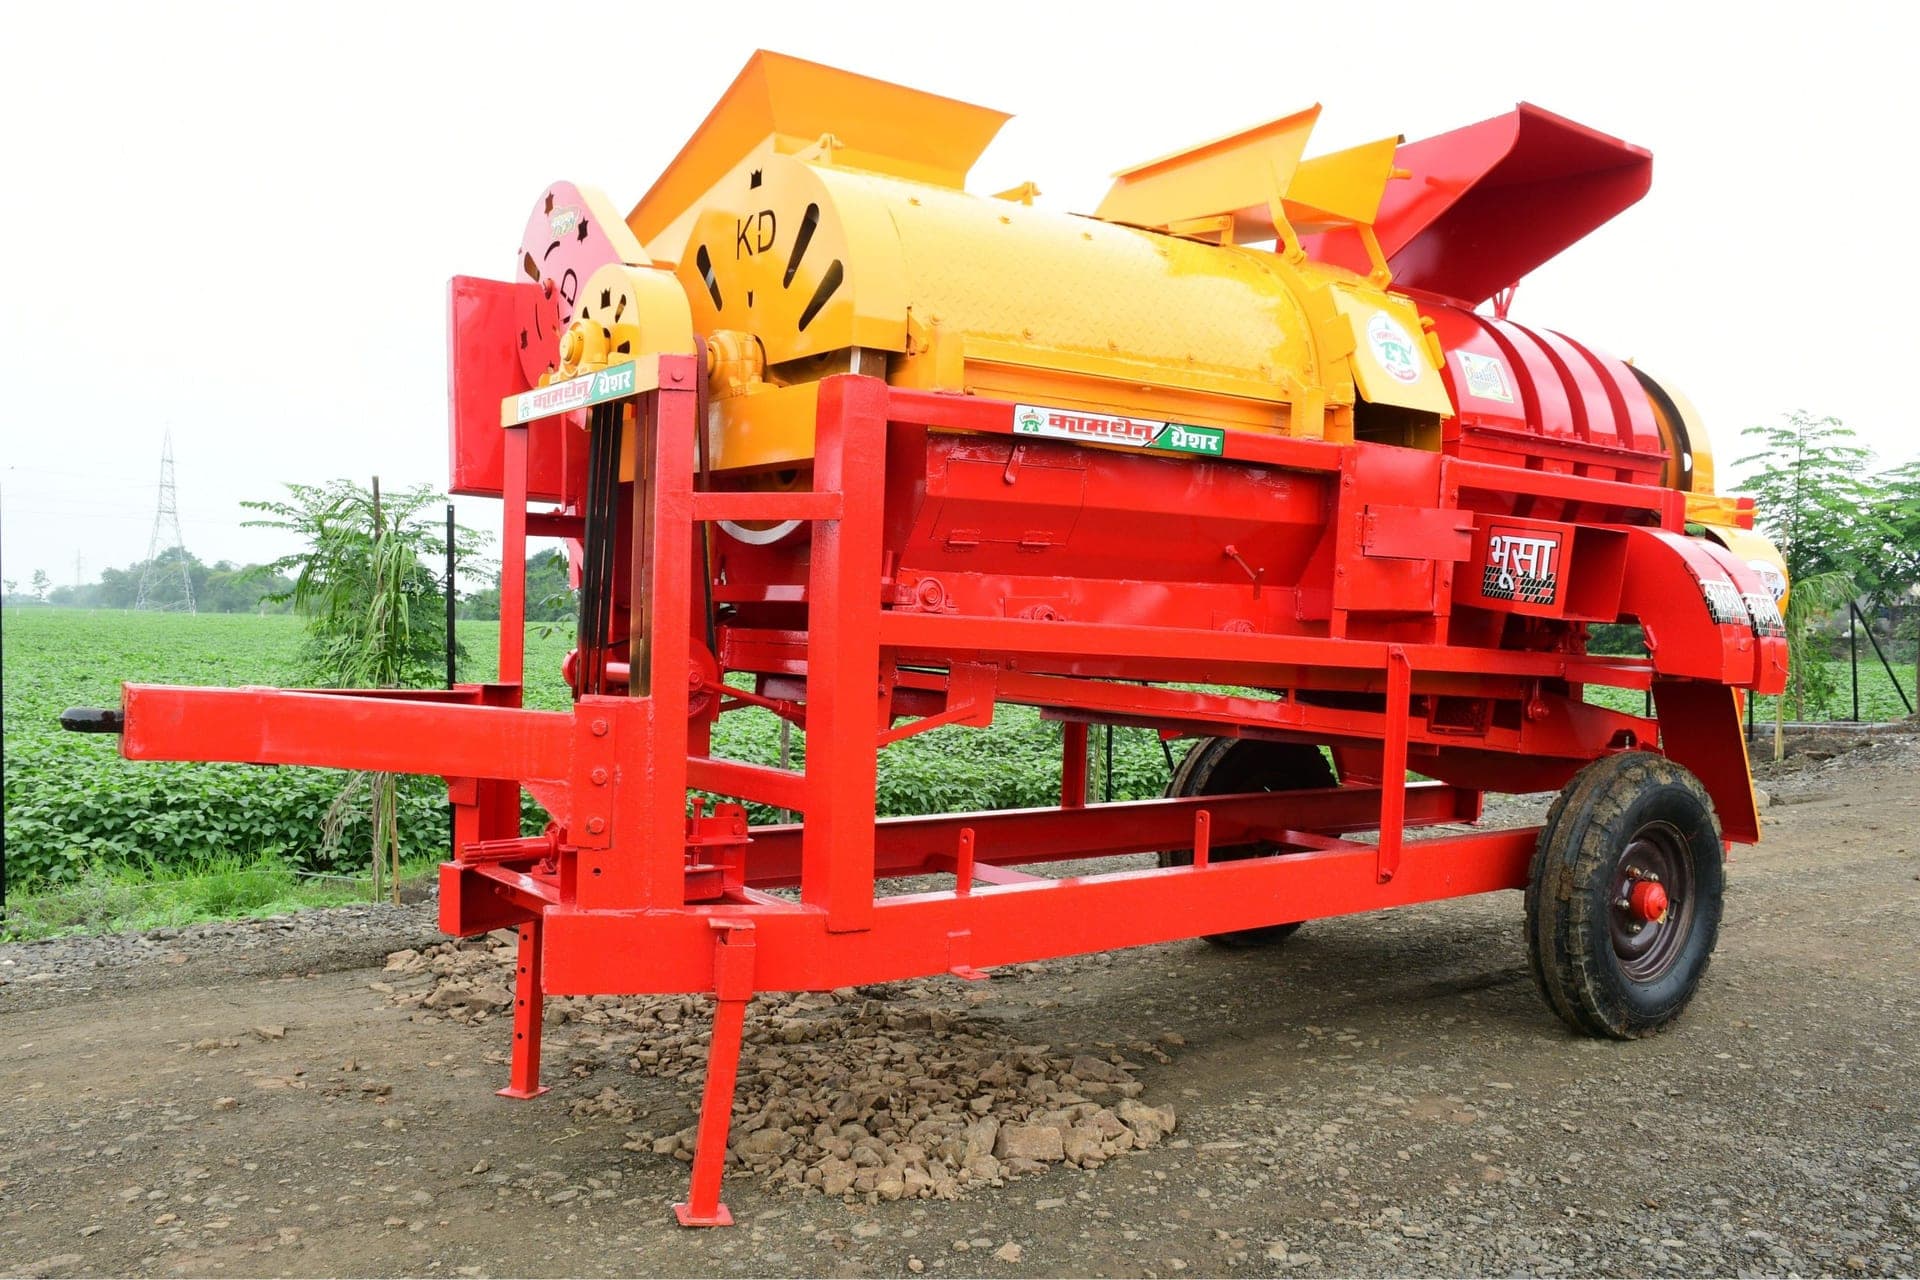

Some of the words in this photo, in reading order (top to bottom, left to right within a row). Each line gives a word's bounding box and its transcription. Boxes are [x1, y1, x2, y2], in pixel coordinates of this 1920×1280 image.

[736, 209, 776, 260] KD
[1171, 425, 1220, 450] थ्रेशर
[1491, 536, 1557, 591] भूसा
